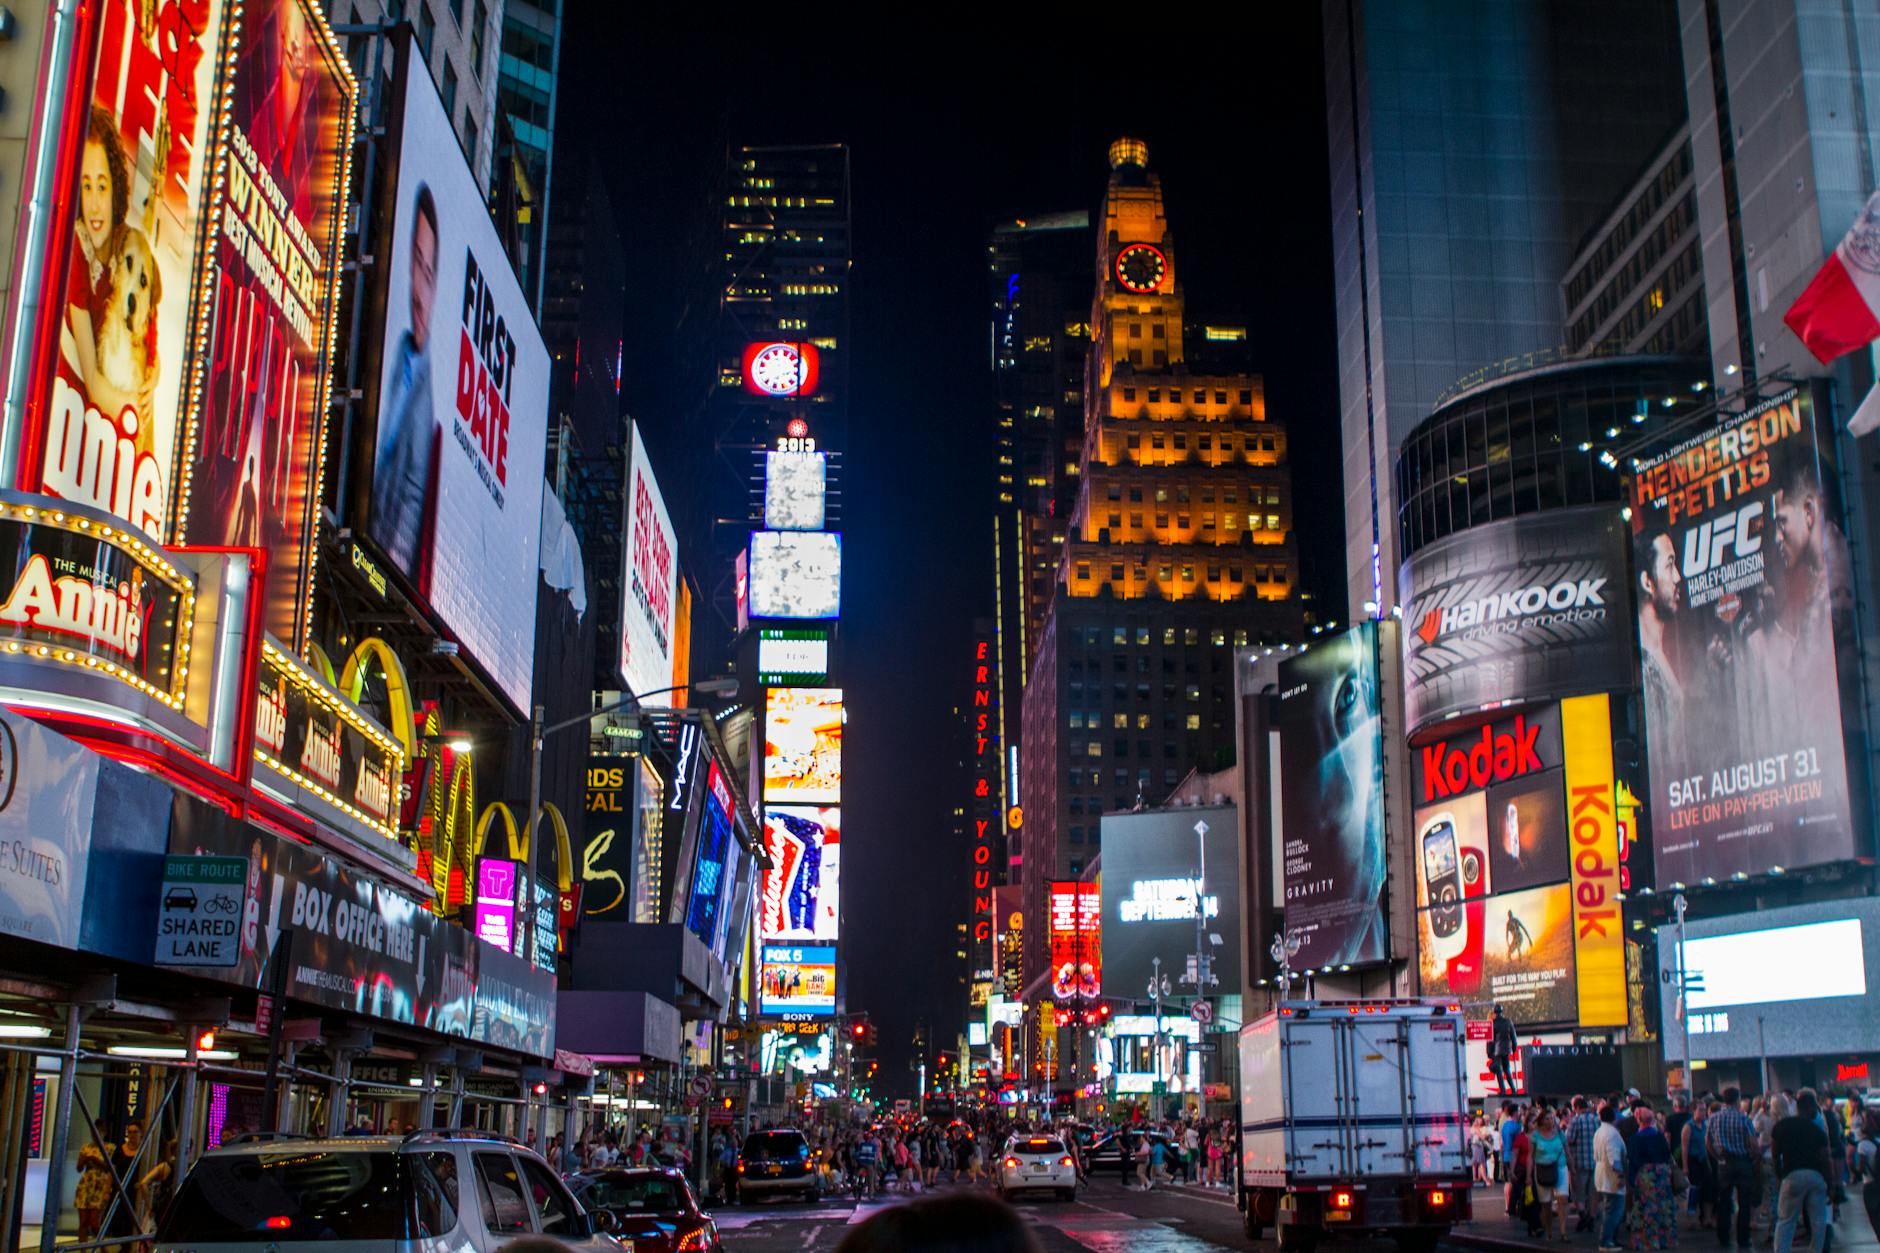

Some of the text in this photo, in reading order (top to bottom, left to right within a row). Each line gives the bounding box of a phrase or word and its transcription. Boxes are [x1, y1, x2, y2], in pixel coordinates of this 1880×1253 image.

[229, 151, 319, 317] WINNER!
[259, 161, 288, 219] TONY
[287, 209, 321, 271] AWARD
[223, 202, 248, 257] BEST
[246, 234, 283, 309] MUSICAL
[462, 244, 517, 410] FIRST
[456, 325, 511, 488] DATE
[777, 437, 816, 452] 2013
[1635, 388, 1799, 473] WORLD LIGHTWEIGHT CHAMPIONSHIP
[1636, 398, 1801, 505] HENDERSON
[1668, 450, 1771, 526] PETTIS
[1683, 501, 1764, 579] UFC
[54, 557, 118, 588] THE MUSICAL
[1688, 552, 1765, 595] HARLEY-DAVIDSON
[0, 554, 141, 659] Annie
[1690, 584, 1725, 609] HOMETOWN
[1463, 607, 1606, 641] driving emotion
[301, 716, 341, 788] Annie
[606, 726, 642, 739] LAMAR
[587, 767, 624, 787] DS
[1423, 714, 1544, 802] Kodak
[1669, 747, 1821, 808] SAT. AUGUST 31
[586, 793, 623, 812] AL
[975, 641, 989, 941] ERNST & YOUNG
[1670, 780, 1823, 830] LIVE ON PAY-PER-VIEW
[167, 863, 241, 877] BIKE ROUTE
[1286, 844, 1309, 857] BULLOCK
[1286, 862, 1312, 875] CLOONEY
[1571, 783, 1617, 940] Kodak
[1287, 878, 1334, 899] GRAVITY
[162, 918, 236, 936] SHARED
[292, 881, 334, 936] BOX
[335, 902, 384, 953] OFFICE
[386, 922, 414, 965] HERE
[172, 941, 221, 958] LANE
[765, 949, 791, 962] FOX
[1506, 973, 1517, 985] FOR
[1517, 972, 1528, 983] THE
[1540, 970, 1553, 980] YOU
[783, 1013, 814, 1021] SONY
[1531, 1046, 1616, 1056] MARQUIS
[128, 1063, 142, 1117] ONEY
[352, 1065, 399, 1082] FFICE
